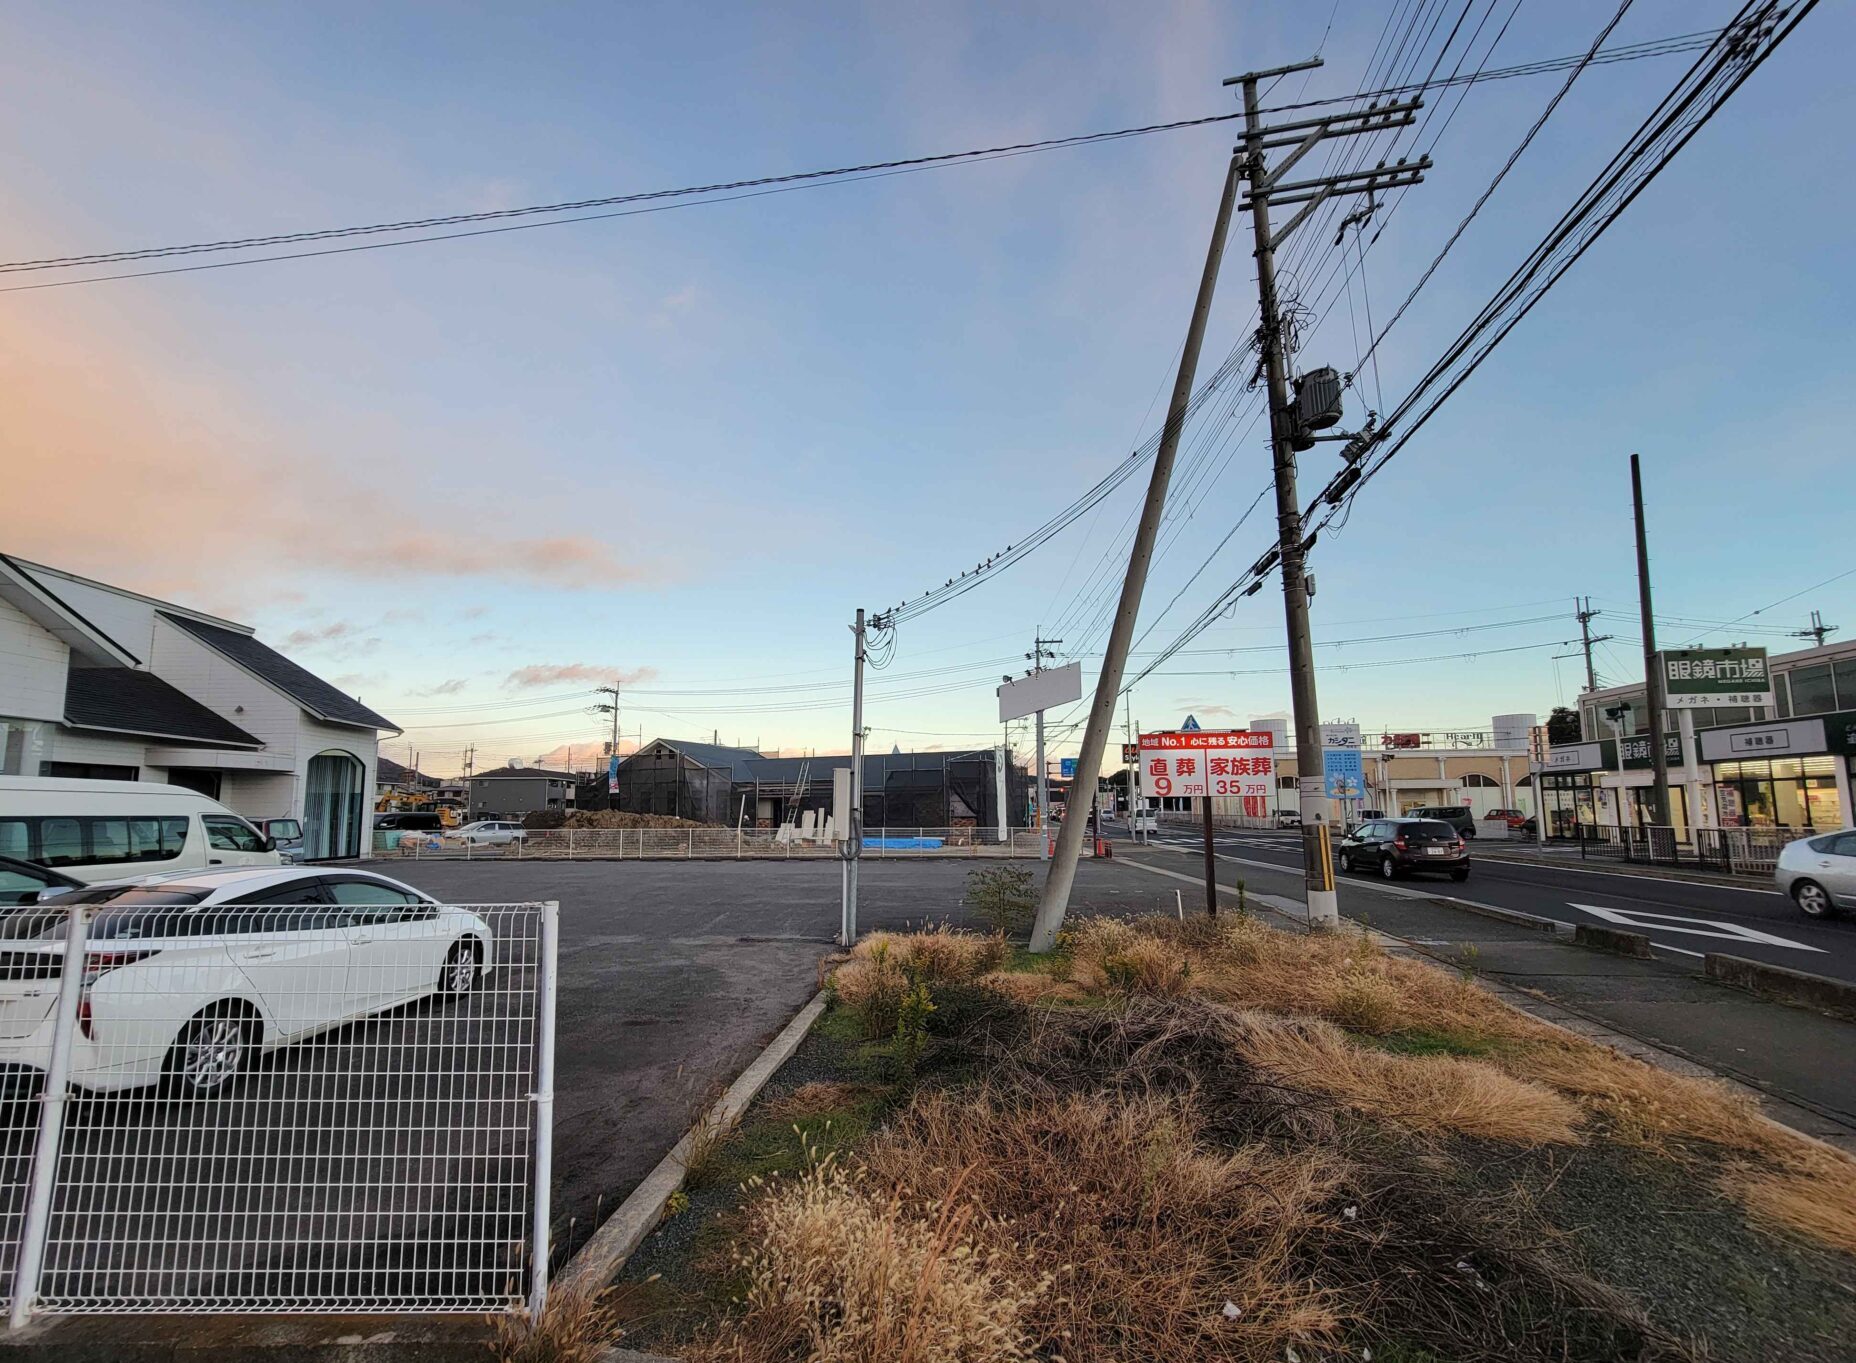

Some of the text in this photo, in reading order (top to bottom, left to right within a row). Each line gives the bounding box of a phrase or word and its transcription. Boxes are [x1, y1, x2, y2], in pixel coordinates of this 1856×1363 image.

[1667, 658, 1765, 680] 眼鏡市場
[1141, 735, 1270, 747] 地域 No.1 心に残る 安心価格
[1620, 737, 1680, 760] 眼鏡場
[1124, 754, 1139, 762] Syl
[1150, 757, 1196, 777] 直葬
[1210, 757, 1272, 776] 家族葬
